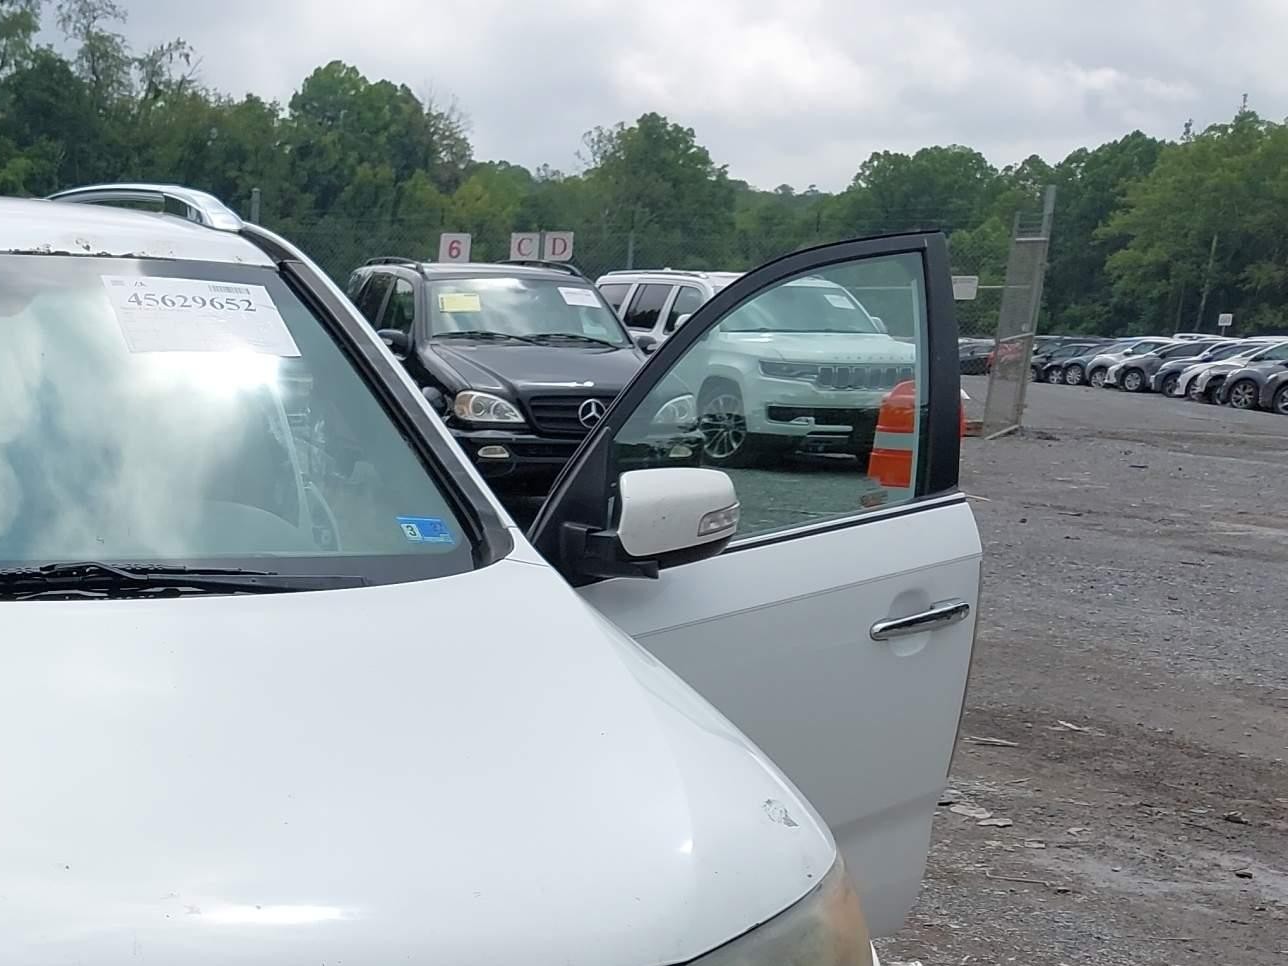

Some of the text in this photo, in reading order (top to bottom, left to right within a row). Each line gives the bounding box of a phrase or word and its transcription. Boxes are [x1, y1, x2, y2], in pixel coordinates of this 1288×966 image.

[449, 240, 461, 258] 6
[517, 237, 567, 256] C D
[128, 291, 257, 313] 45629652
